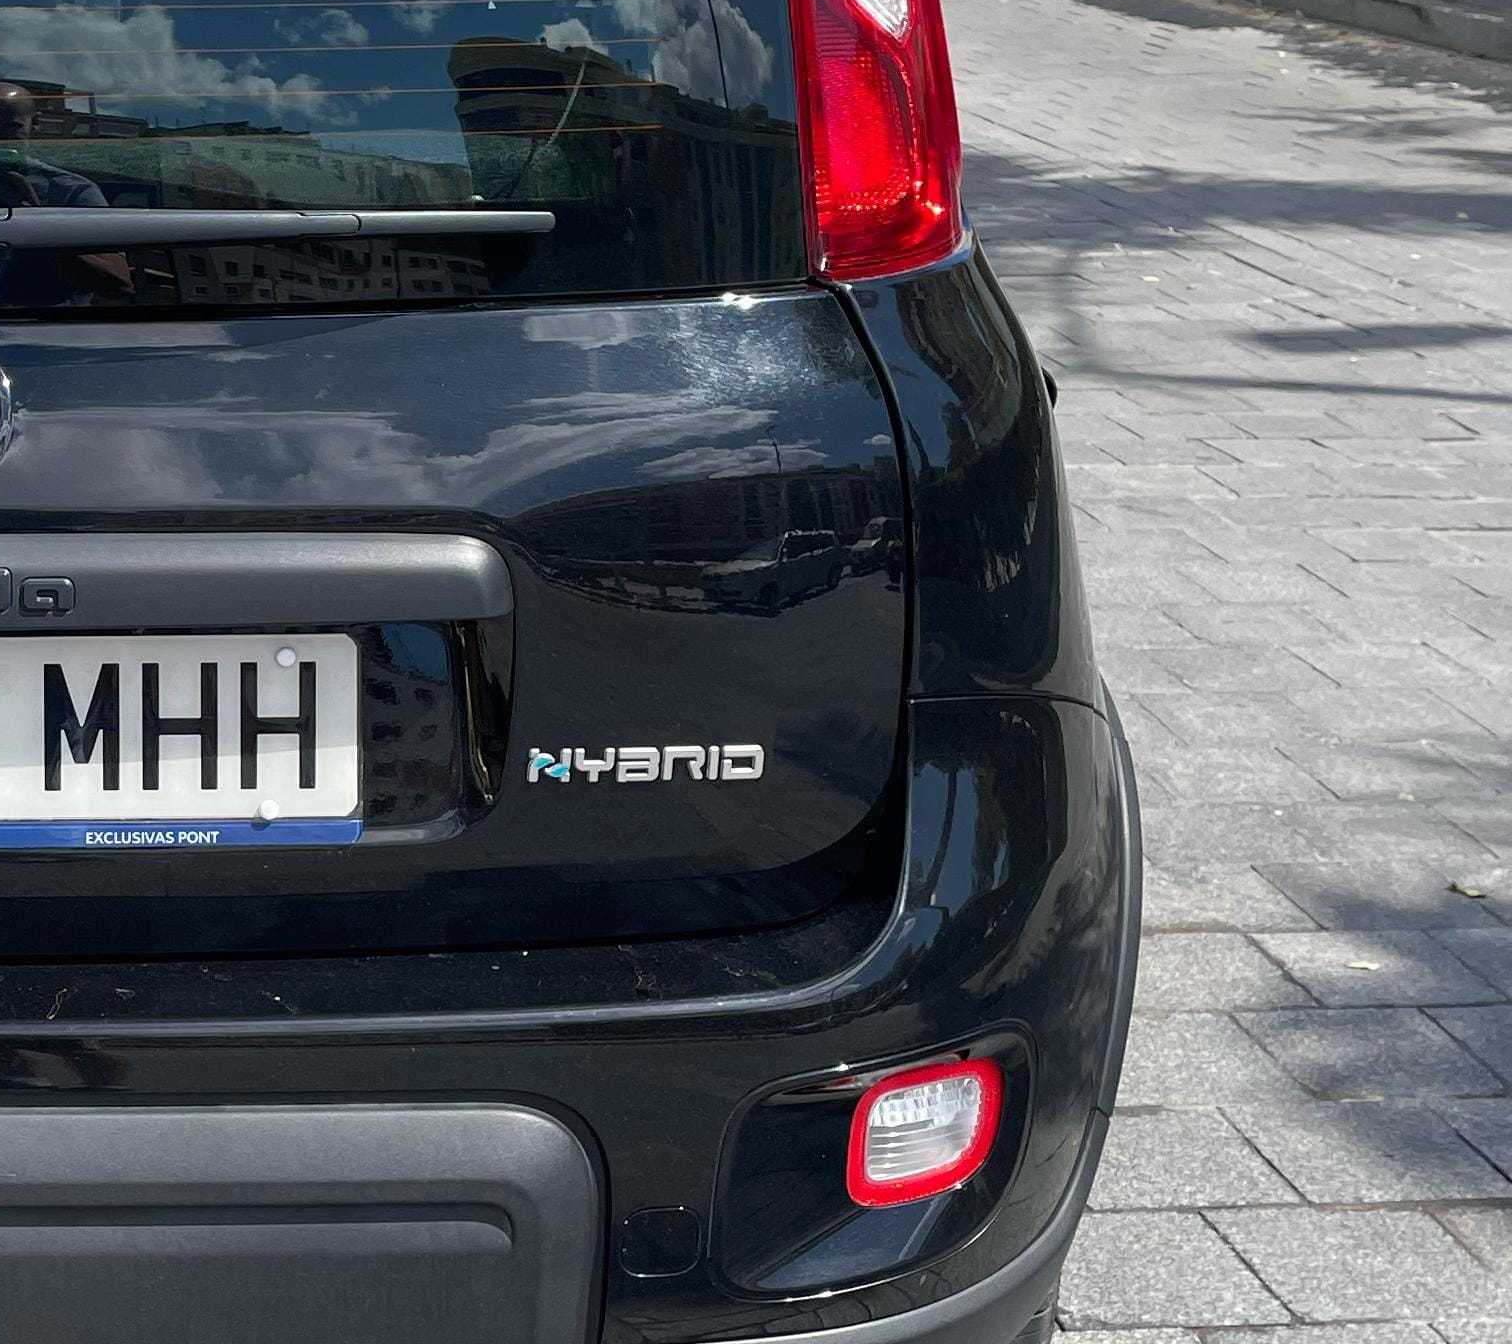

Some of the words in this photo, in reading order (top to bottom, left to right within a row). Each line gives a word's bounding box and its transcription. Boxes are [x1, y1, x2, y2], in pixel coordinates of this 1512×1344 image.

[43, 661, 317, 791] MHH
[527, 745, 765, 783] HYBRID
[85, 831, 174, 844] EXCLUSIVAS
[178, 831, 220, 844] PONT
